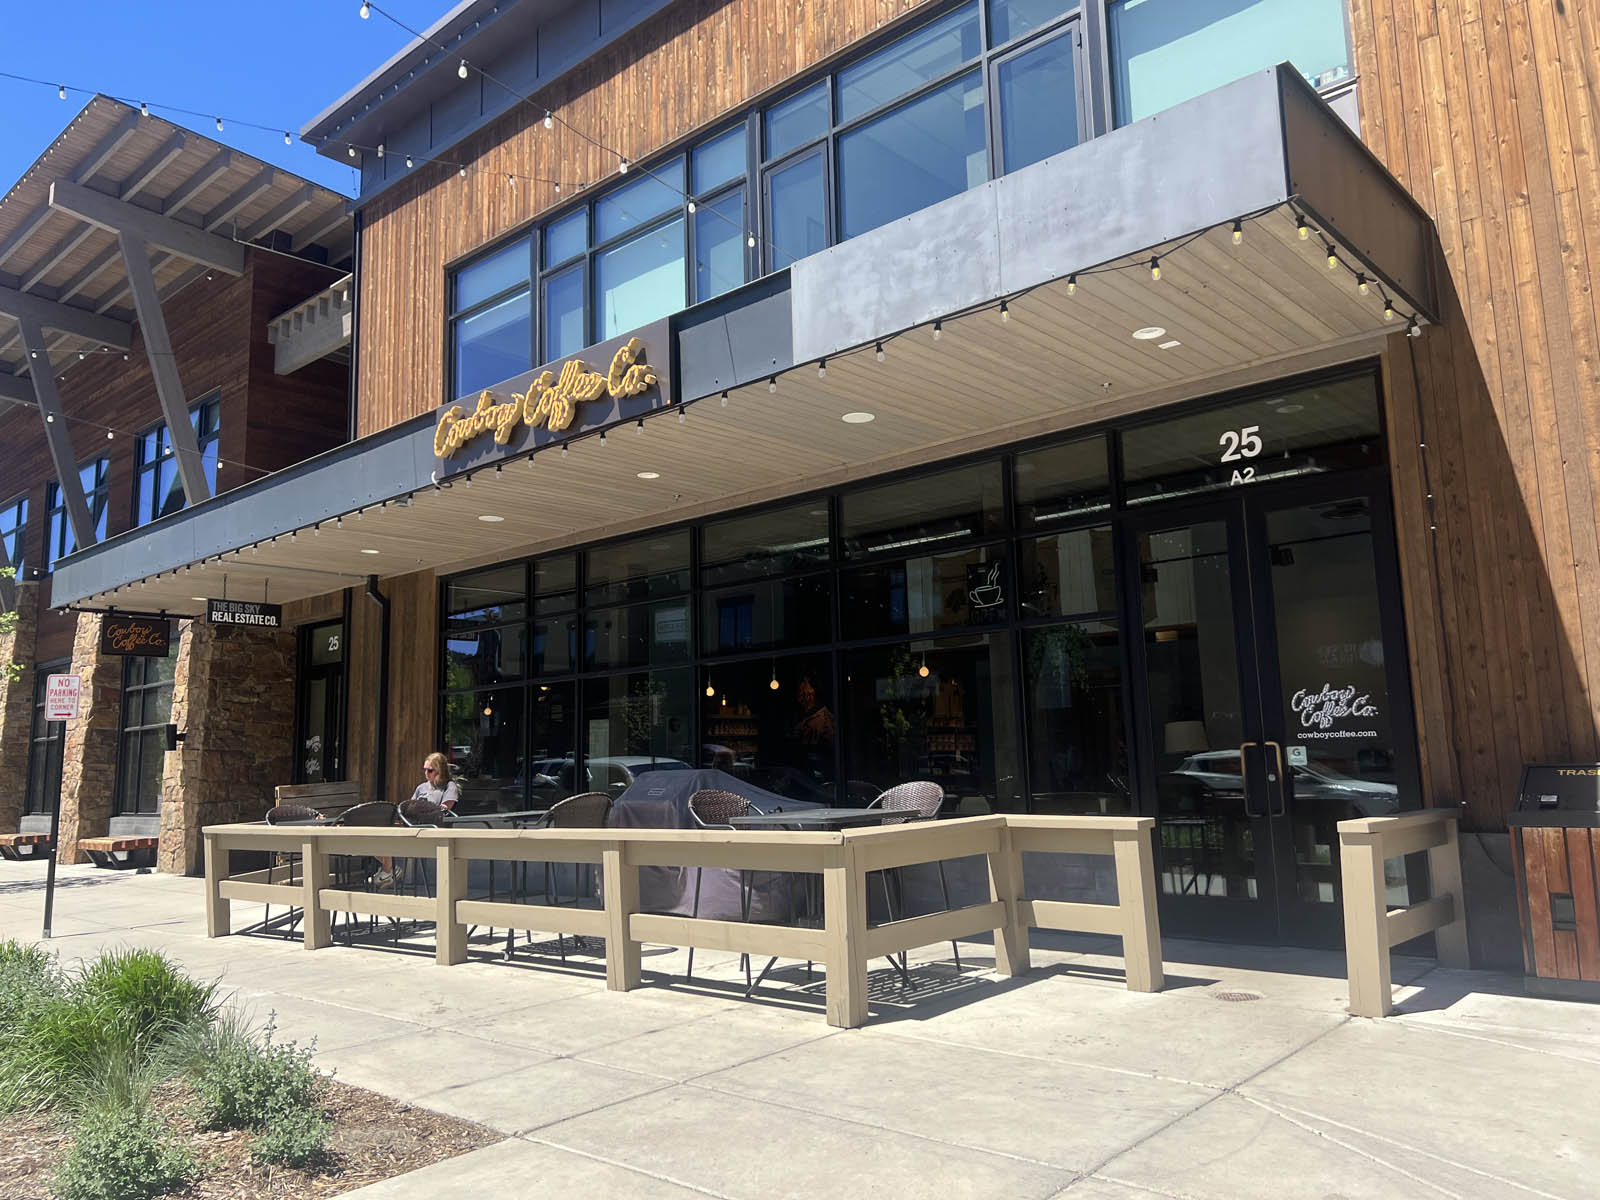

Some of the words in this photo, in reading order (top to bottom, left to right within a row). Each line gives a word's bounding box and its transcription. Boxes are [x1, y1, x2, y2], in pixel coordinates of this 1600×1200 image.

[434, 391, 524, 458] Cowboy
[523, 360, 607, 432] Coffee
[607, 337, 656, 398] Co.
[1219, 425, 1263, 463] 25
[1230, 467, 1257, 486] A2
[213, 601, 228, 612] THE
[229, 602, 243, 613] BIG
[244, 603, 260, 614] SKY
[212, 611, 234, 623] REAL
[235, 613, 264, 625] ESTATE
[264, 615, 279, 626] CO.
[106, 622, 152, 639] Cowboy
[112, 633, 149, 652] Coffee
[328, 635, 340, 651] 25
[57, 679, 71, 687] NO
[49, 689, 78, 697] PARKING
[1291, 683, 1356, 712] Cowboy
[1301, 701, 1352, 729] Coffee
[1352, 694, 1379, 717] Co.
[1297, 730, 1378, 740] cowboycoffee.com
